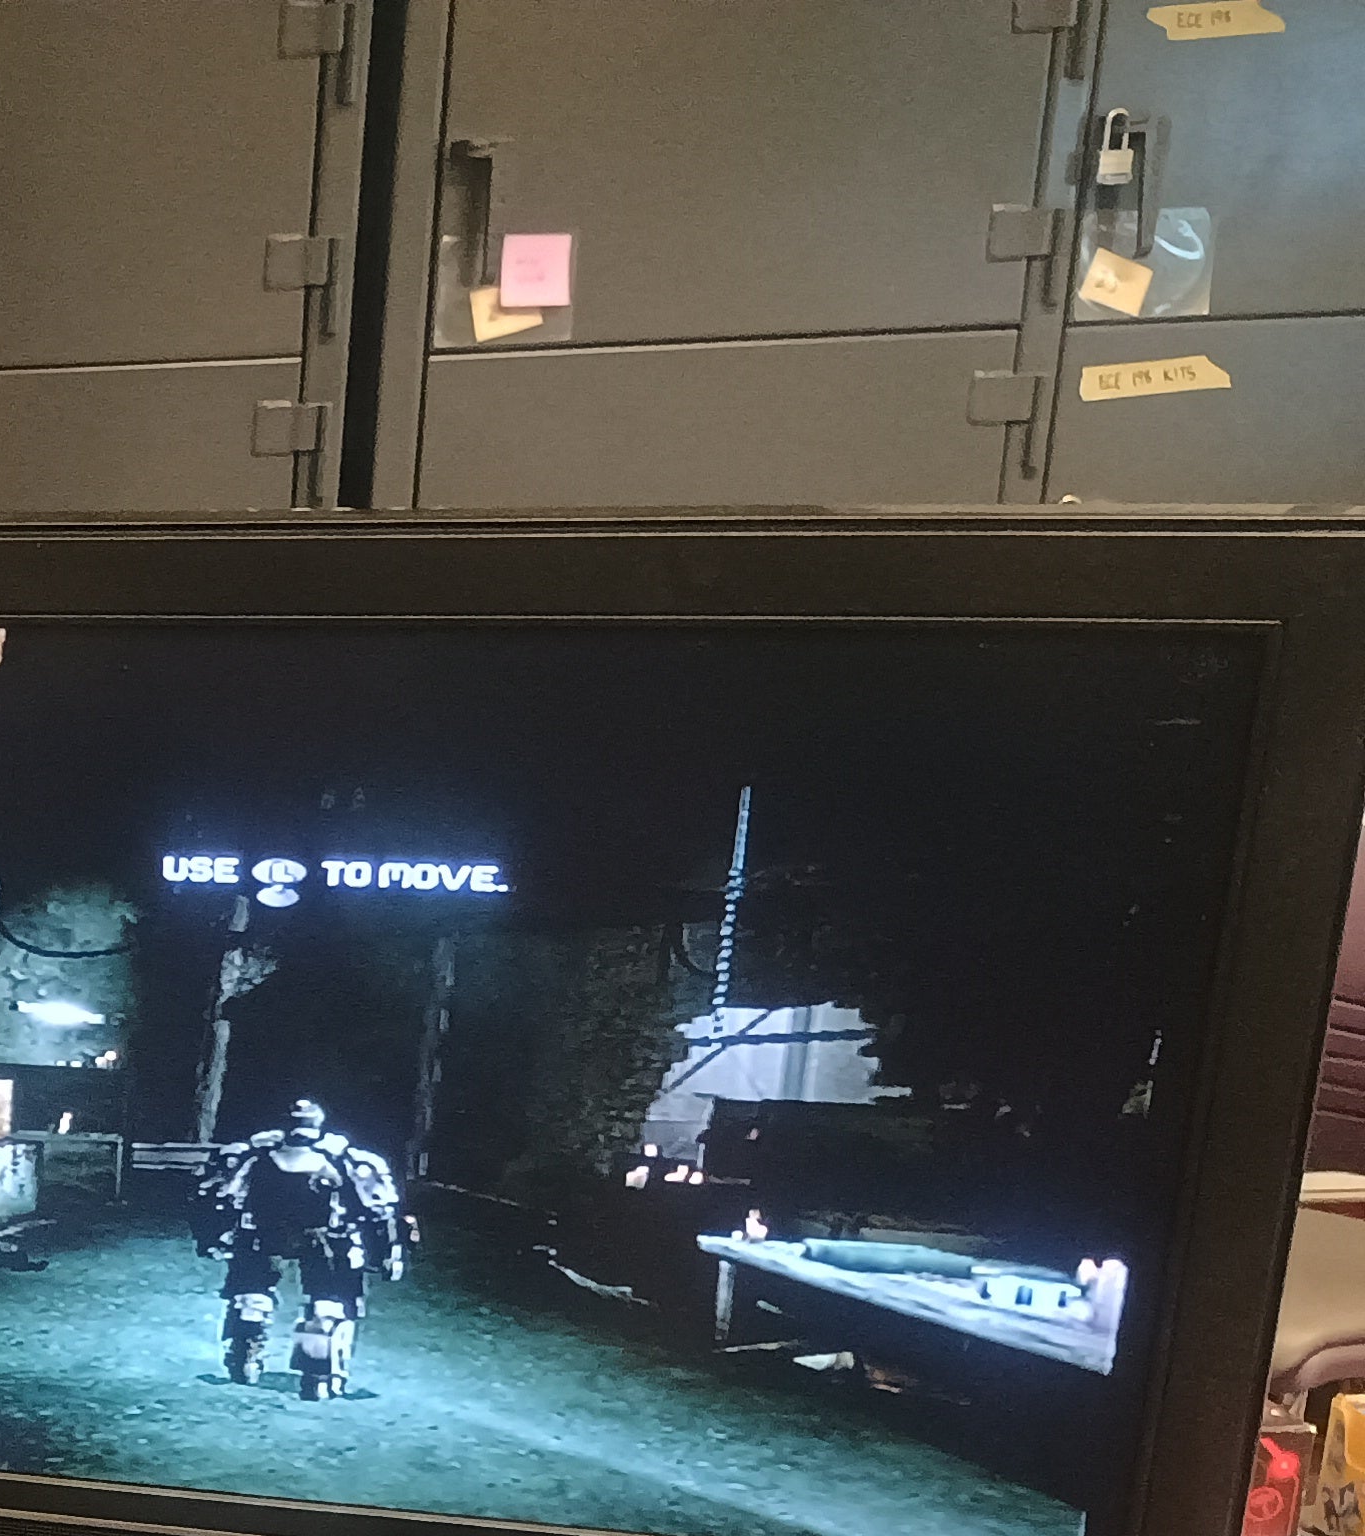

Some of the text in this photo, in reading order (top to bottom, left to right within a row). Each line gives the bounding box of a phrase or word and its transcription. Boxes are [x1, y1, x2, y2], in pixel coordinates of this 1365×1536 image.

[1163, 365, 1197, 382] KITS
[162, 855, 240, 884] USE
[320, 859, 372, 889] TO
[378, 862, 509, 893] MOVE.
